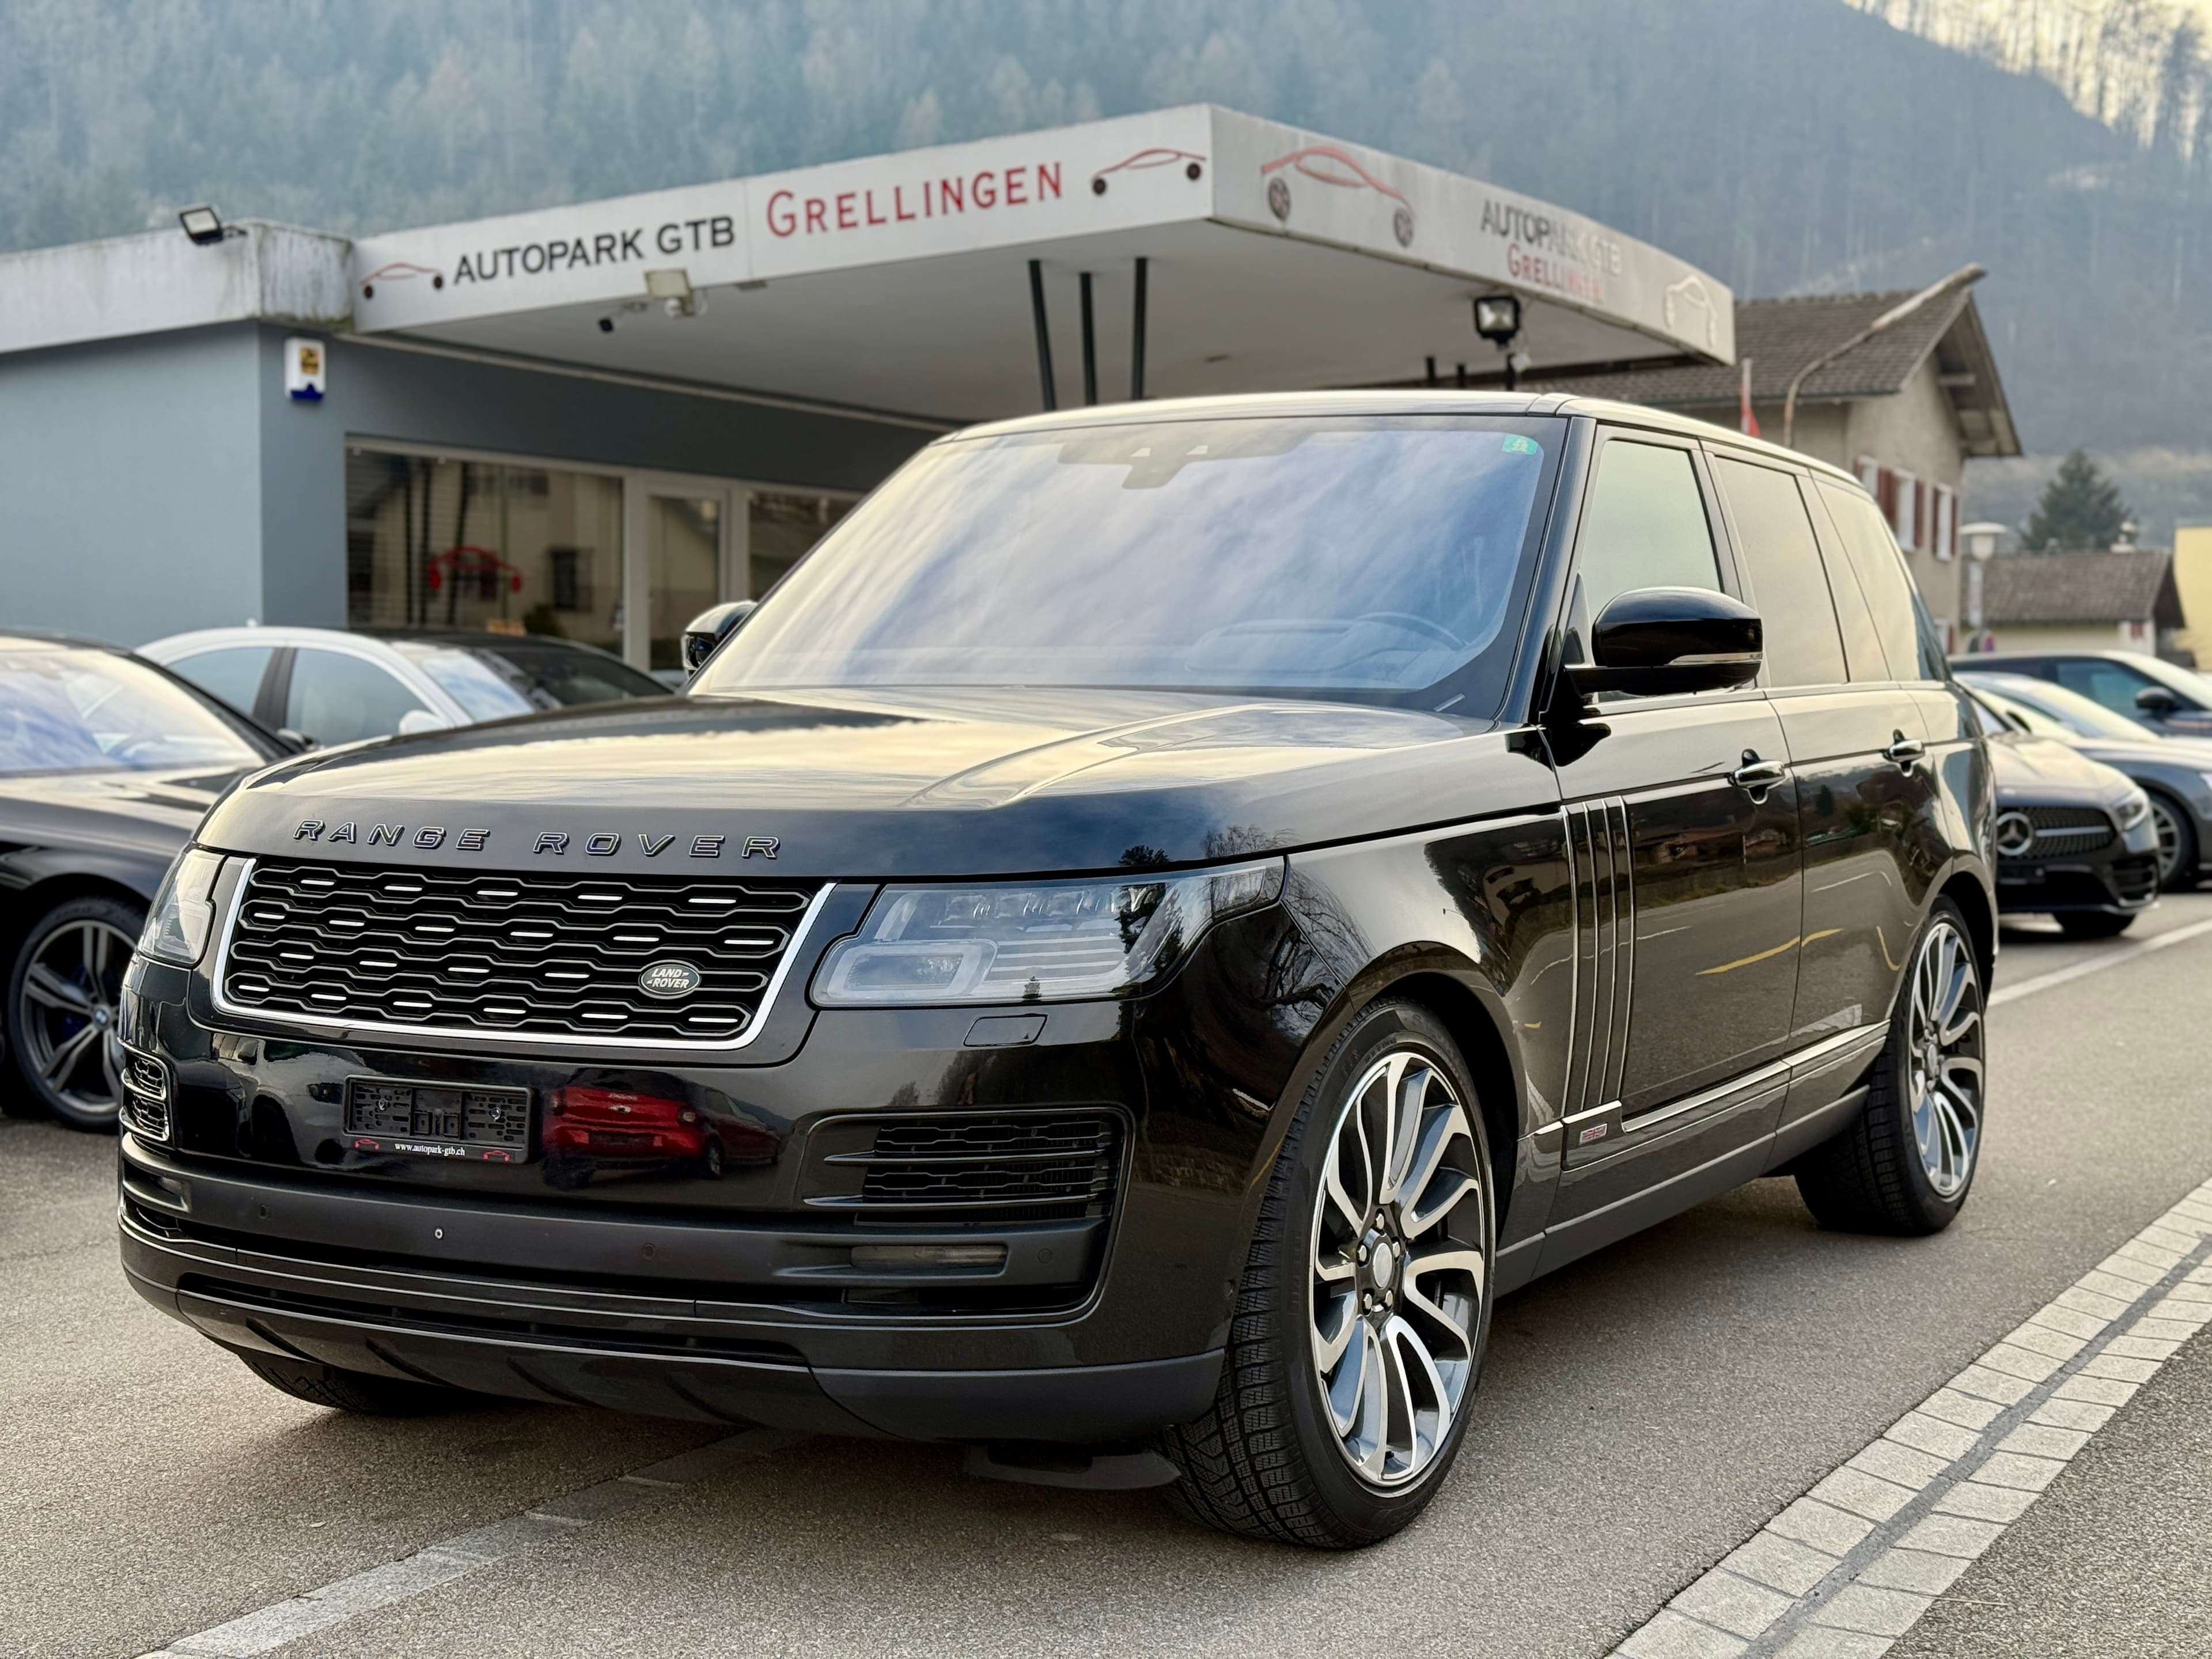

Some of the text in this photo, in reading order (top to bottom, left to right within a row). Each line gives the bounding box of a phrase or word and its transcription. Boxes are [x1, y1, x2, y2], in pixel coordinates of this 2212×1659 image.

[454, 161, 1063, 285] AUTOPARK GTB GRELLINGEN
[292, 819, 781, 859] RANGE ROVER
[395, 1143, 465, 1157] www.autopark-gtb.ch
